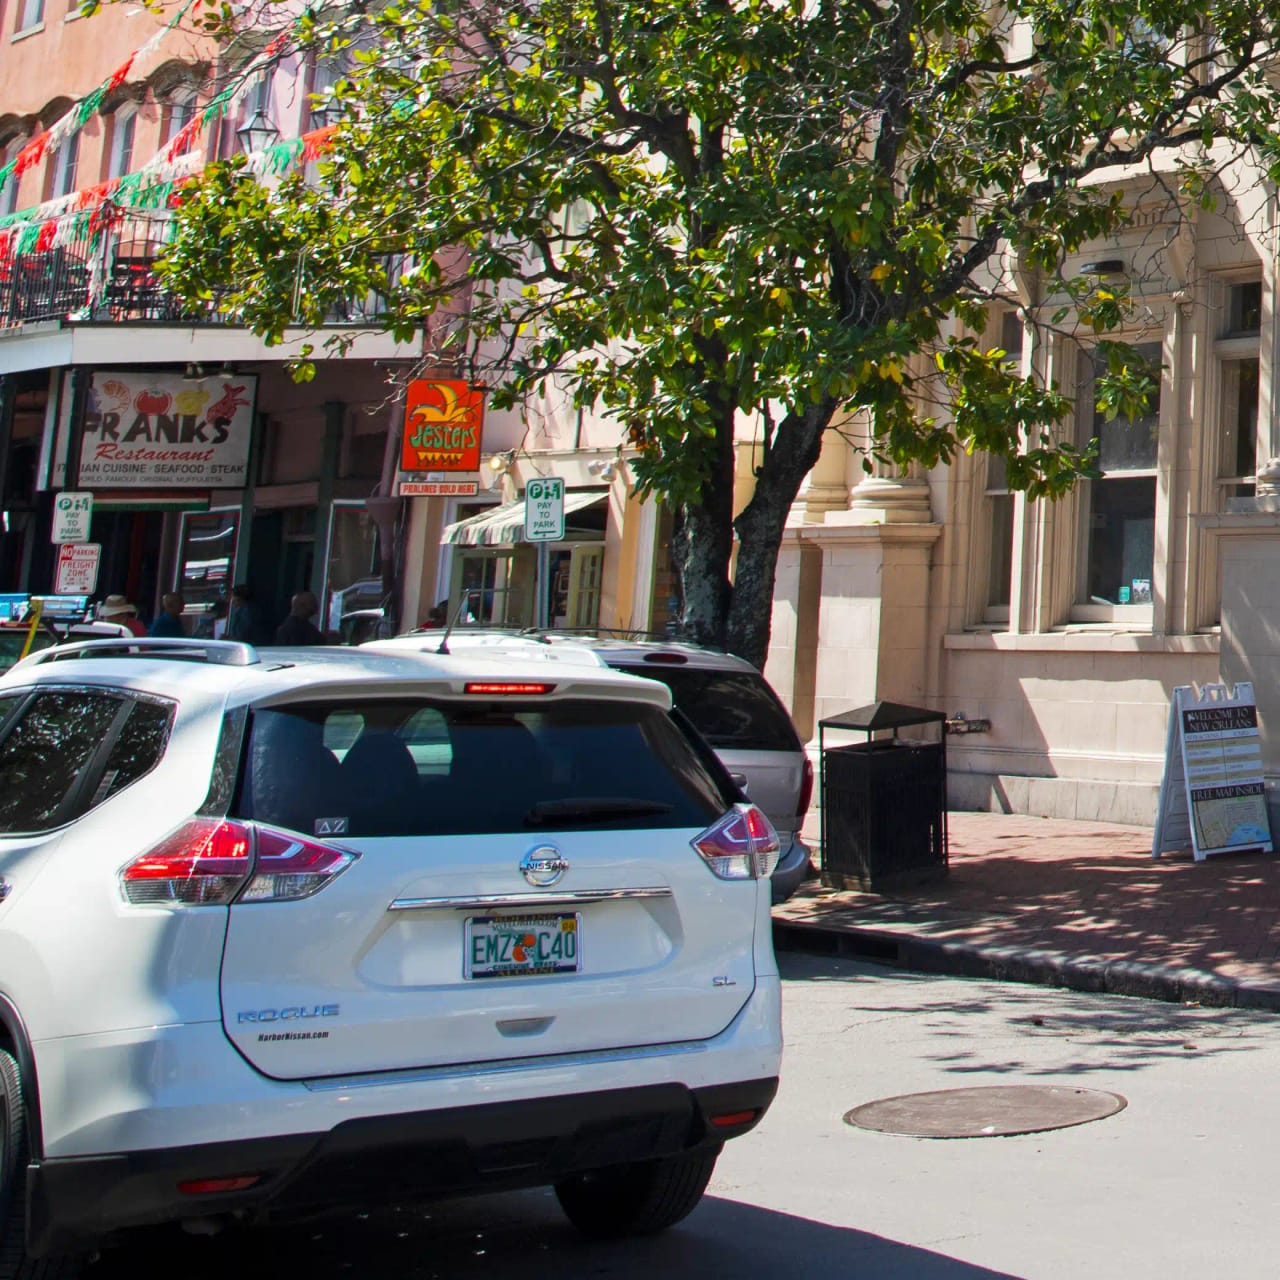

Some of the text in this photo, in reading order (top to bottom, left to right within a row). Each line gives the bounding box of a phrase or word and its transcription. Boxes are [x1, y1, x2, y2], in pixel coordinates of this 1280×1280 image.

[94, 442, 215, 461] Restaurant
[57, 463, 244, 475] ITIAN CUISINE SEAFOOD STEAK
[536, 502, 553, 510] PAY
[540, 511, 550, 519] TO
[68, 519, 78, 527] TO
[62, 547, 73, 557] NO
[62, 561, 94, 569] FREIGHT
[67, 569, 88, 577] ZONE
[1237, 708, 1249, 718] TO
[1190, 719, 1252, 731] NEW ORLEANS
[1216, 788, 1234, 798] MAP
[1236, 784, 1262, 795] INSIDE
[527, 860, 566, 871] NISSAN
[472, 931, 576, 964] EMZ C40
[712, 976, 737, 986] SL
[237, 1004, 340, 1024] ROGUE
[257, 1030, 329, 1042] HarborNissan.com
